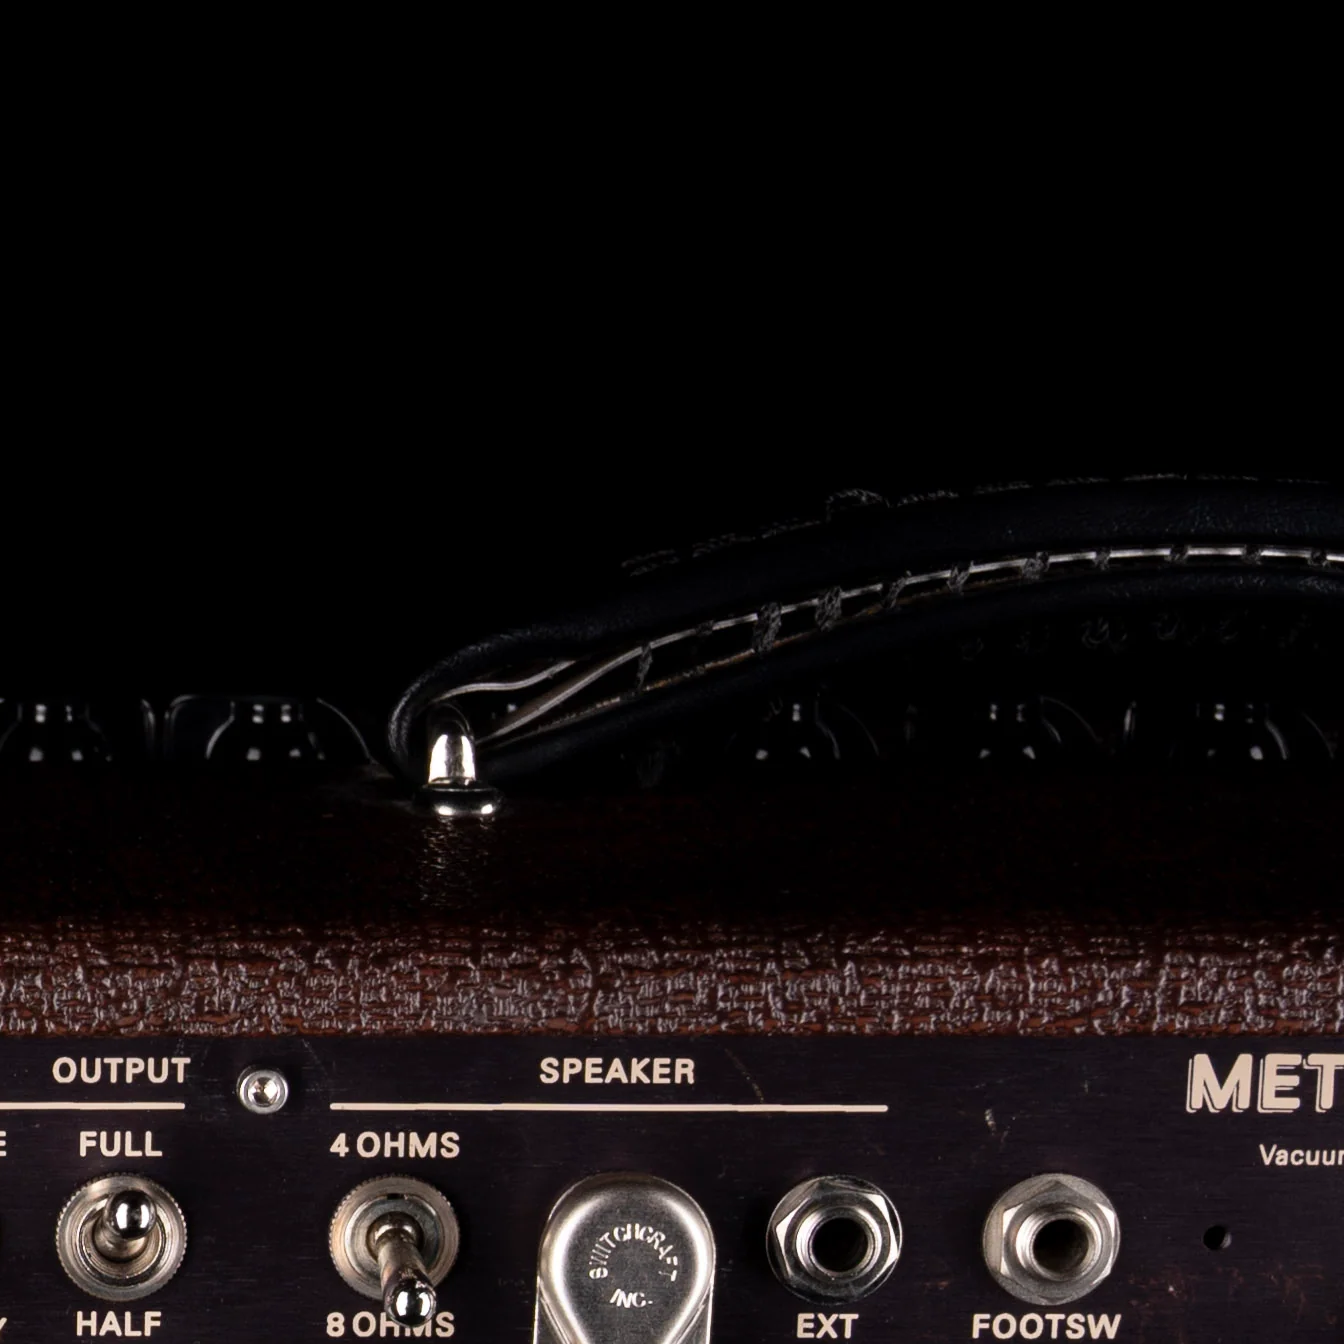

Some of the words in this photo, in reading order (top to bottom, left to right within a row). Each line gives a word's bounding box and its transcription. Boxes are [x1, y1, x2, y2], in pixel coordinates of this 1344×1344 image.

[52, 1056, 191, 1084] OUTPUT
[539, 1057, 695, 1085] SPEAKER
[1185, 1053, 1344, 1114] MET
[79, 1130, 163, 1158] FULL
[330, 1132, 350, 1158] 4
[356, 1131, 460, 1159] OHMS
[76, 1310, 162, 1337] HALF
[326, 1311, 345, 1338] 8
[796, 1312, 860, 1339] EXT
[972, 1312, 1122, 1340] FOOTSW
